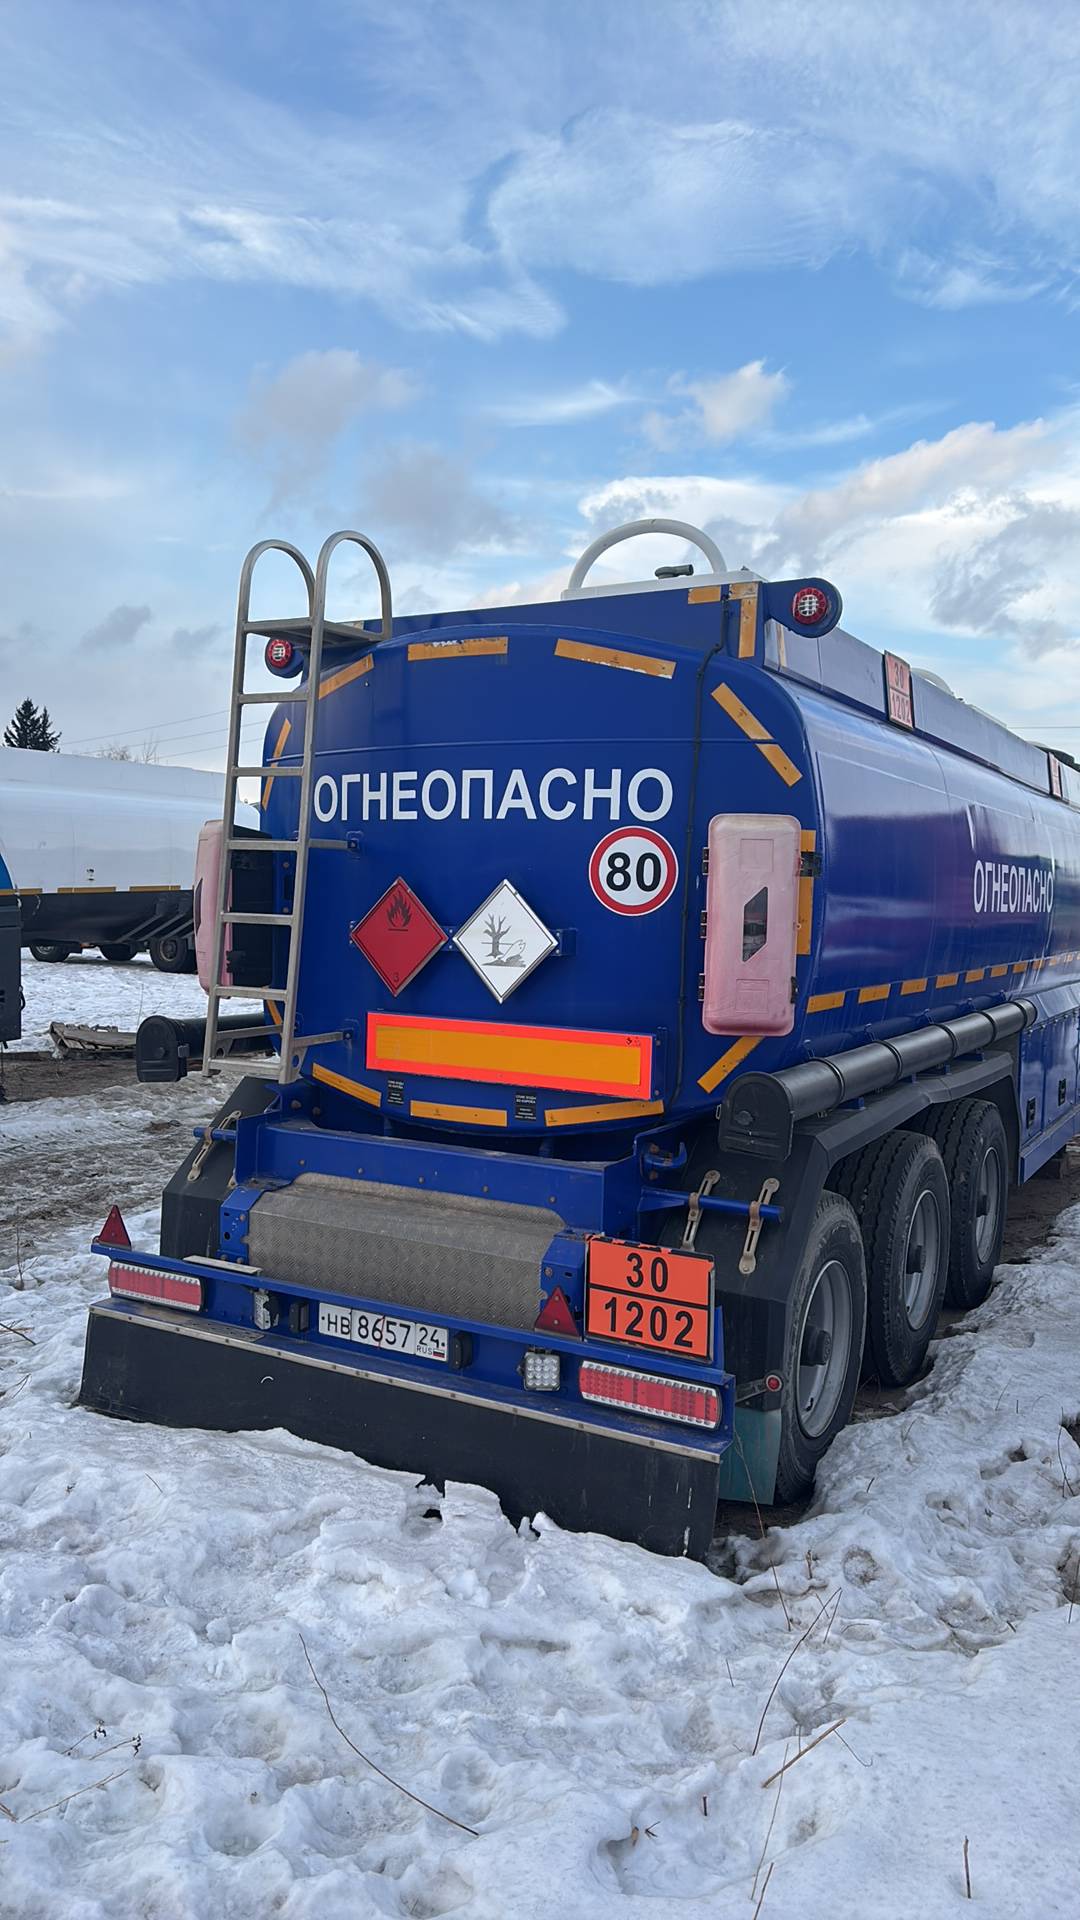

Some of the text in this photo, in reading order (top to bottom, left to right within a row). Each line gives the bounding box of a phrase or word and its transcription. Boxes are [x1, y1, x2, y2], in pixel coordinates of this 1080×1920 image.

[314, 768, 674, 823] ОГНЕОПАСНО
[606, 851, 662, 892] 80
[973, 859, 1054, 913] ОГНЕОПАСНО
[626, 1252, 668, 1293] 30
[358, 1314, 412, 1348] 8657
[418, 1326, 441, 1349] 24
[604, 1296, 694, 1349] 1202
[416, 1344, 433, 1356] RUS
